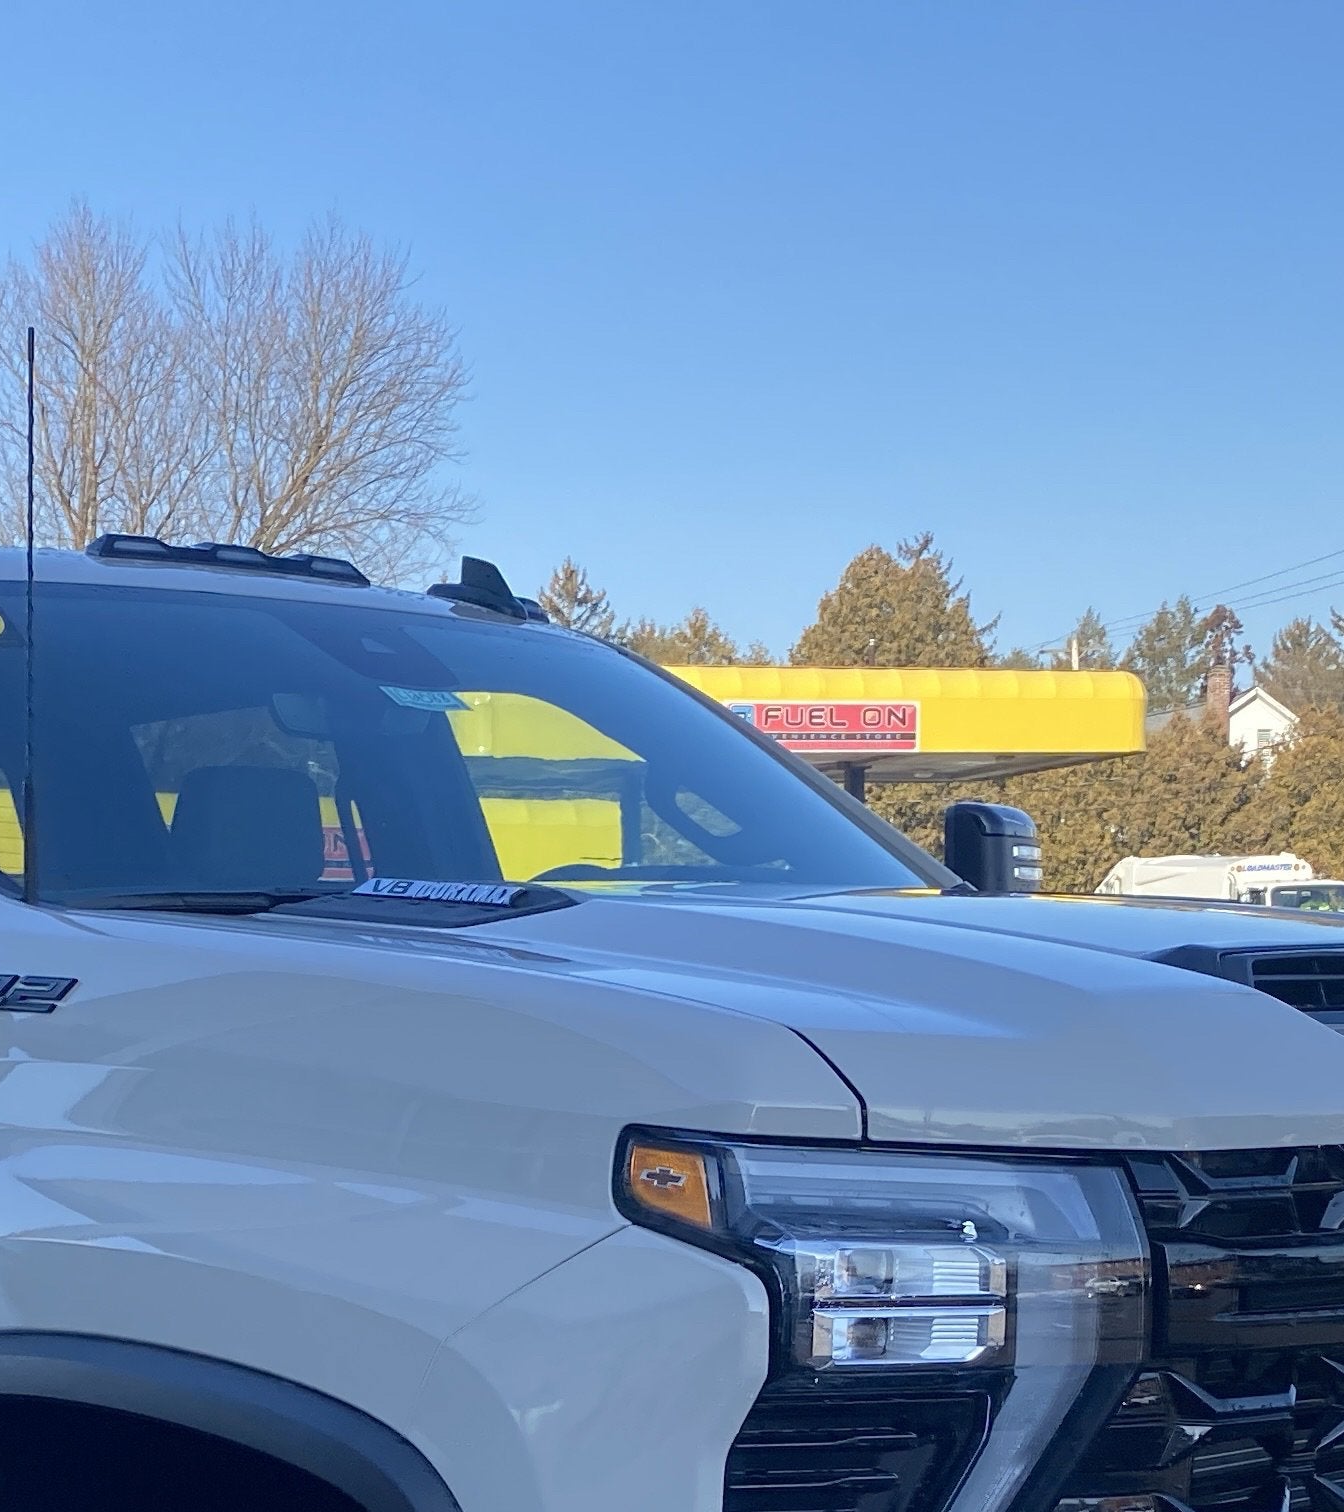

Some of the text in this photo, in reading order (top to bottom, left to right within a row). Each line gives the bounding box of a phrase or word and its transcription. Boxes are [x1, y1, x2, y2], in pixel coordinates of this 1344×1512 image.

[762, 706, 908, 728] FUEL ON
[771, 732, 902, 741] VENIENCE STORE
[372, 879, 414, 894] V8
